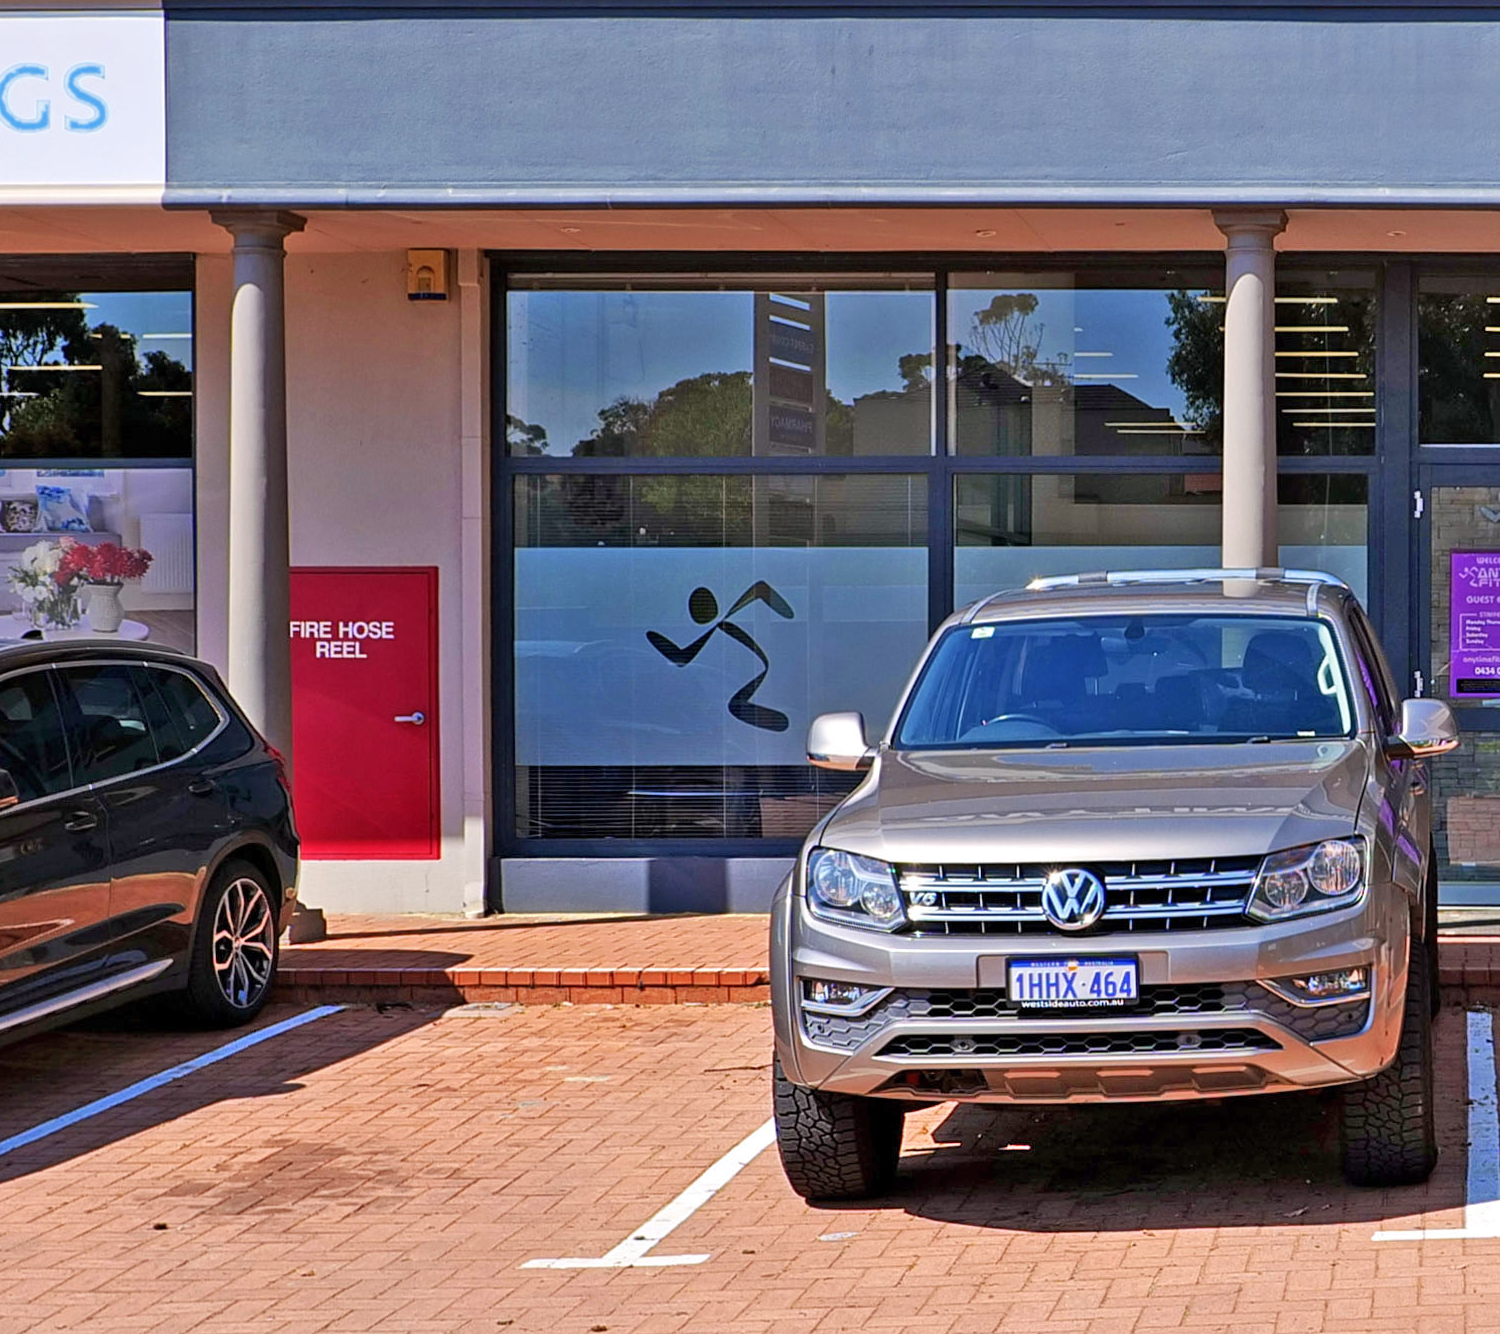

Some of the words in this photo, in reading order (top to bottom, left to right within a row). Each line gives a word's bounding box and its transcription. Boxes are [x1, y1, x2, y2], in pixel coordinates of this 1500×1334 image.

[289, 620, 333, 639] FIRE
[338, 620, 396, 640] HOSE
[315, 640, 368, 659] REEL
[1474, 667, 1496, 676] 0434
[1015, 971, 1078, 999] 1HHX
[1089, 970, 1133, 998] 464
[1020, 998, 1125, 1009] westsideauto.com.au
